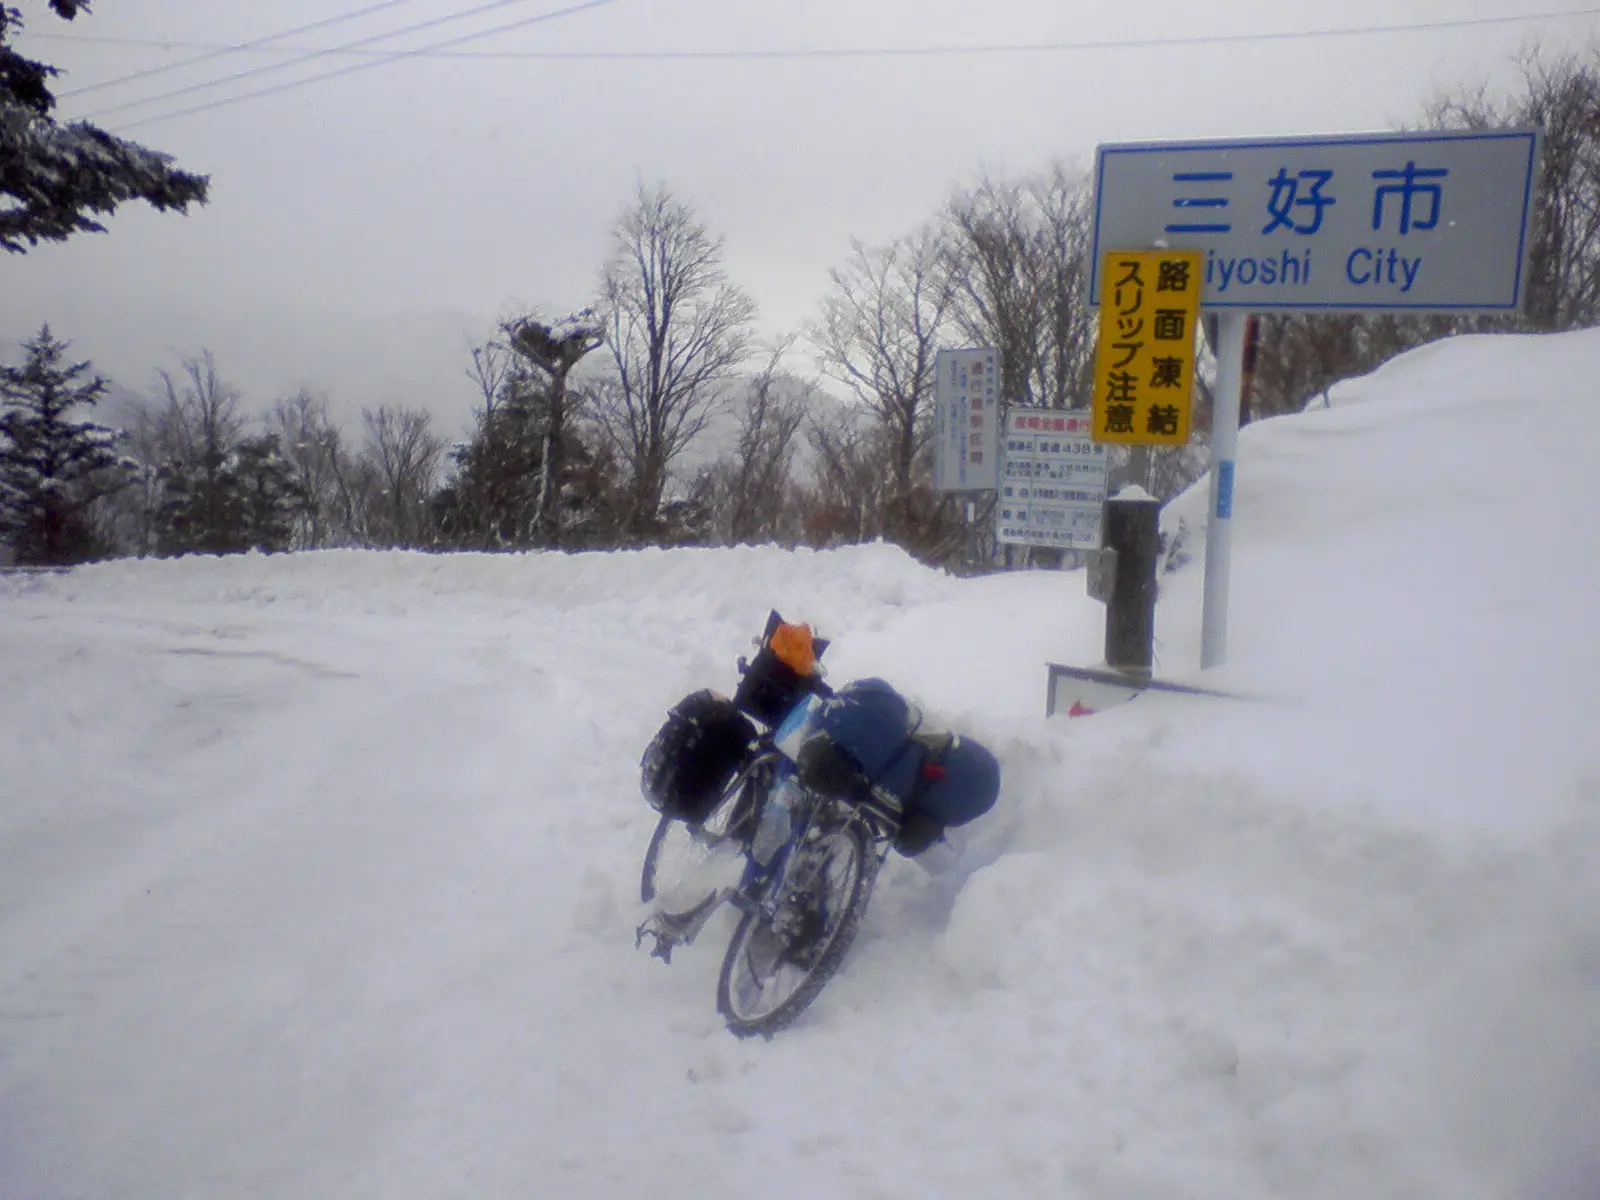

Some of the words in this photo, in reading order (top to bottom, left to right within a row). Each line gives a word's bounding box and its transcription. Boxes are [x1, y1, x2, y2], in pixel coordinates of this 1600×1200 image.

[1165, 161, 1449, 235] 三好市
[1206, 249, 1311, 292] iyoshi
[1346, 247, 1422, 292] City
[1104, 260, 1145, 433] スリップ注意
[1147, 259, 1191, 436] 路面凍結
